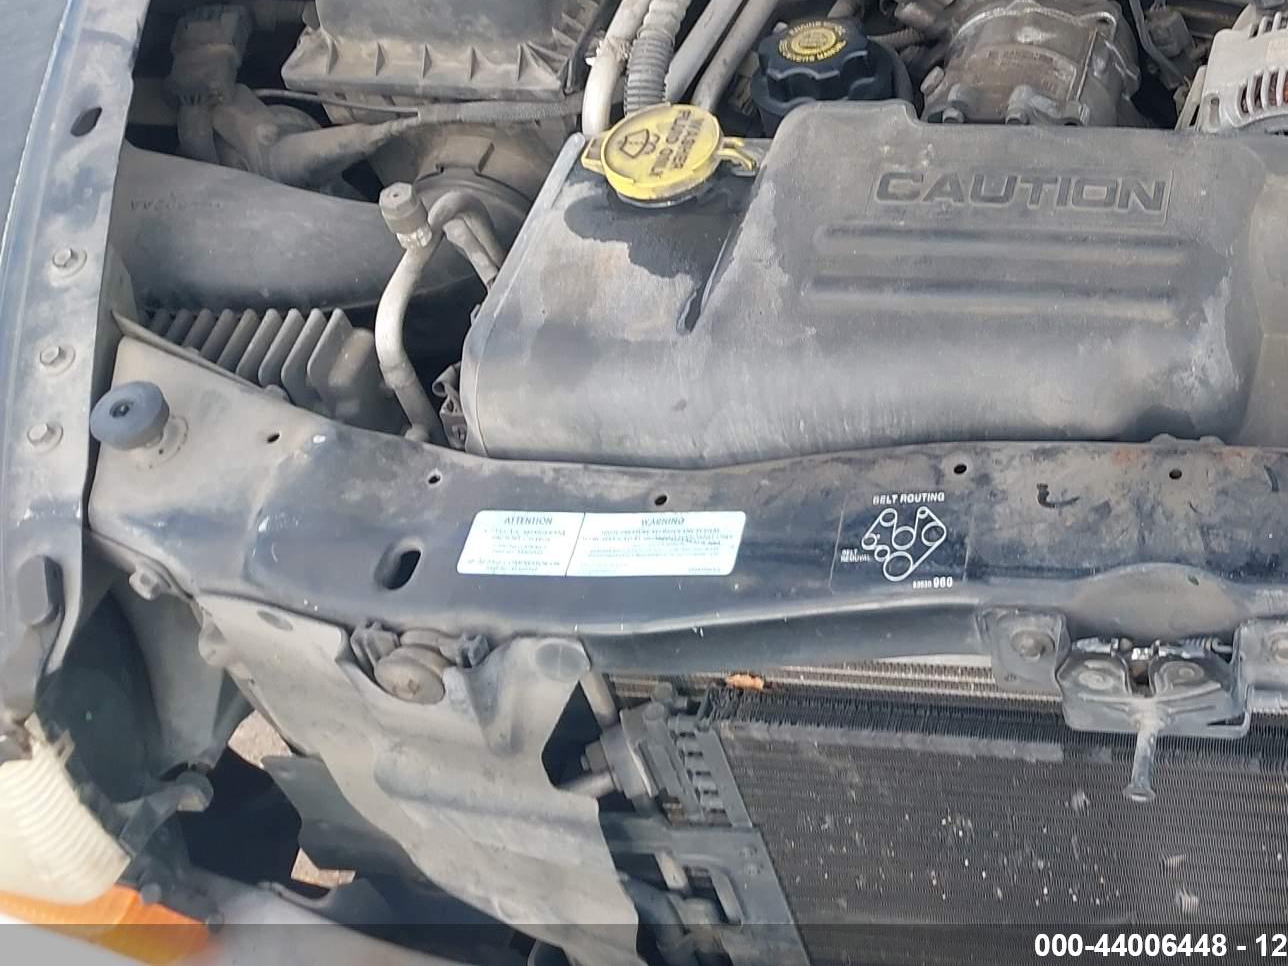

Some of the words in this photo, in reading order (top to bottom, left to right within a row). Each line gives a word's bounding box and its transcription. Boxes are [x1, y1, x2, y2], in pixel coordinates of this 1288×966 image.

[874, 170, 1170, 213] CAUTION
[872, 494, 898, 505] BELT
[900, 492, 945, 504] ROUTING
[504, 516, 552, 526] ATTENTION
[641, 516, 686, 527] WARNING
